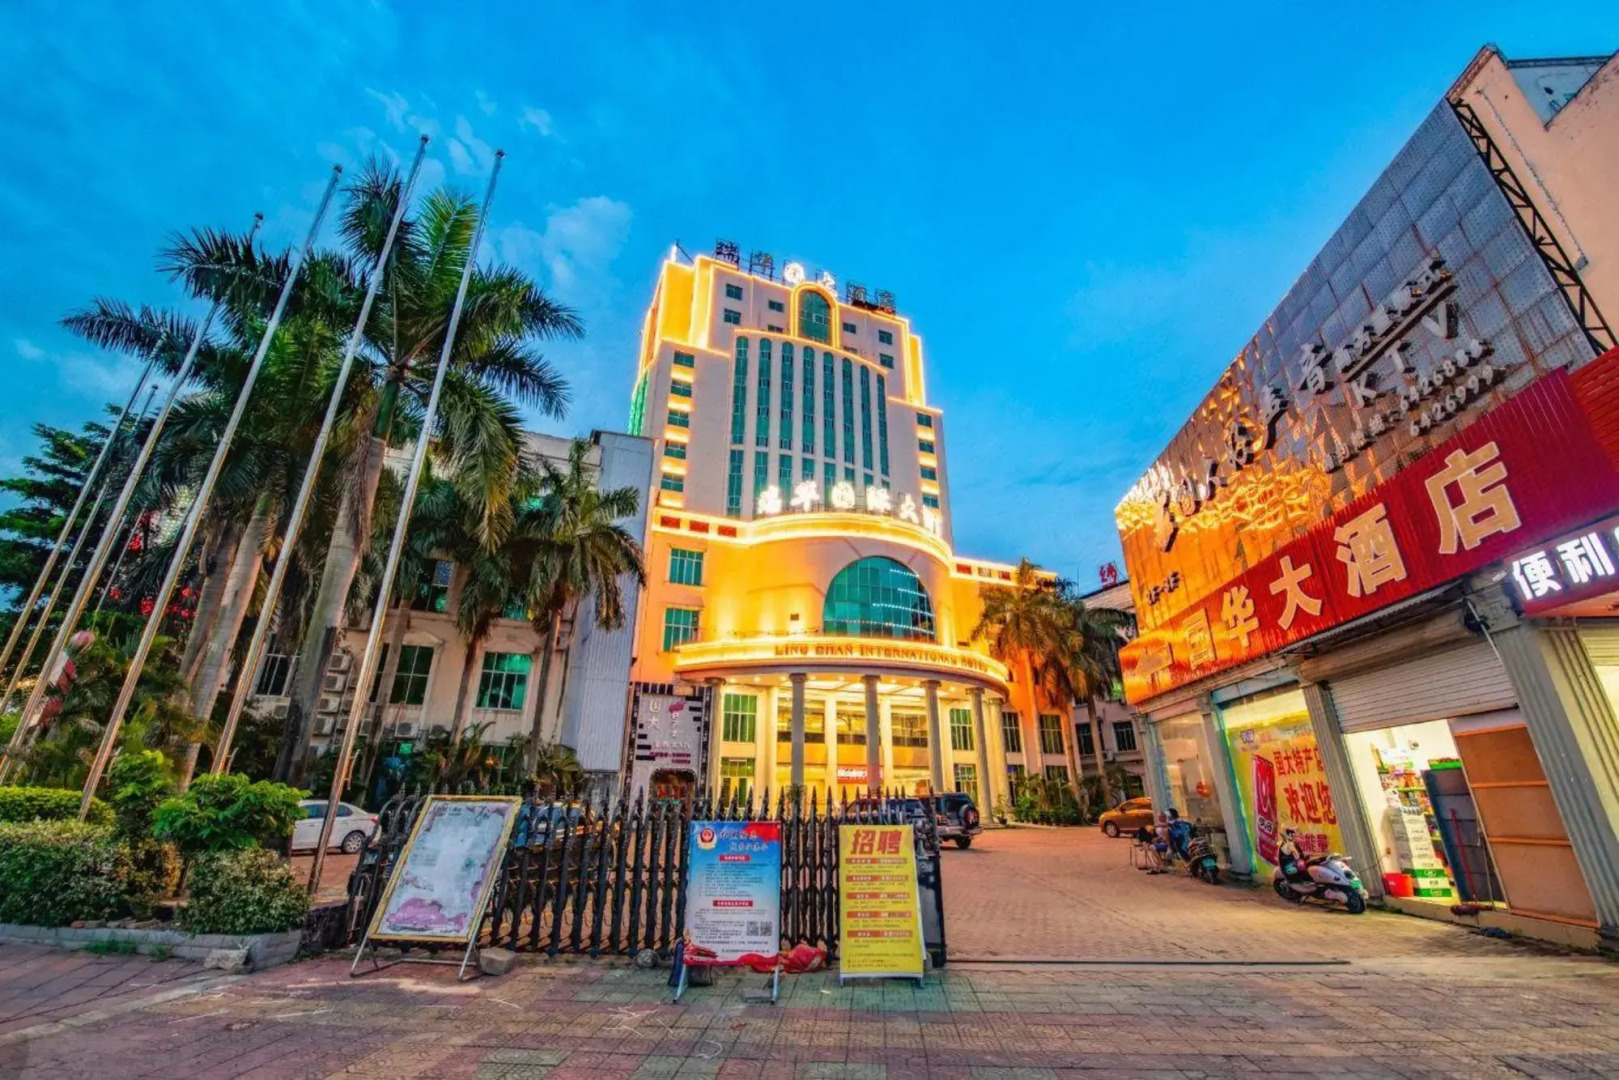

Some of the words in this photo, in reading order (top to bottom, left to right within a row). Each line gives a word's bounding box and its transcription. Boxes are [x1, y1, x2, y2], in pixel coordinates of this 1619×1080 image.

[1409, 364, 1494, 438] 6426999
[1512, 526, 1619, 600] 便利
[1283, 780, 1337, 825] 欢迎您
[850, 829, 902, 855] 招聘
